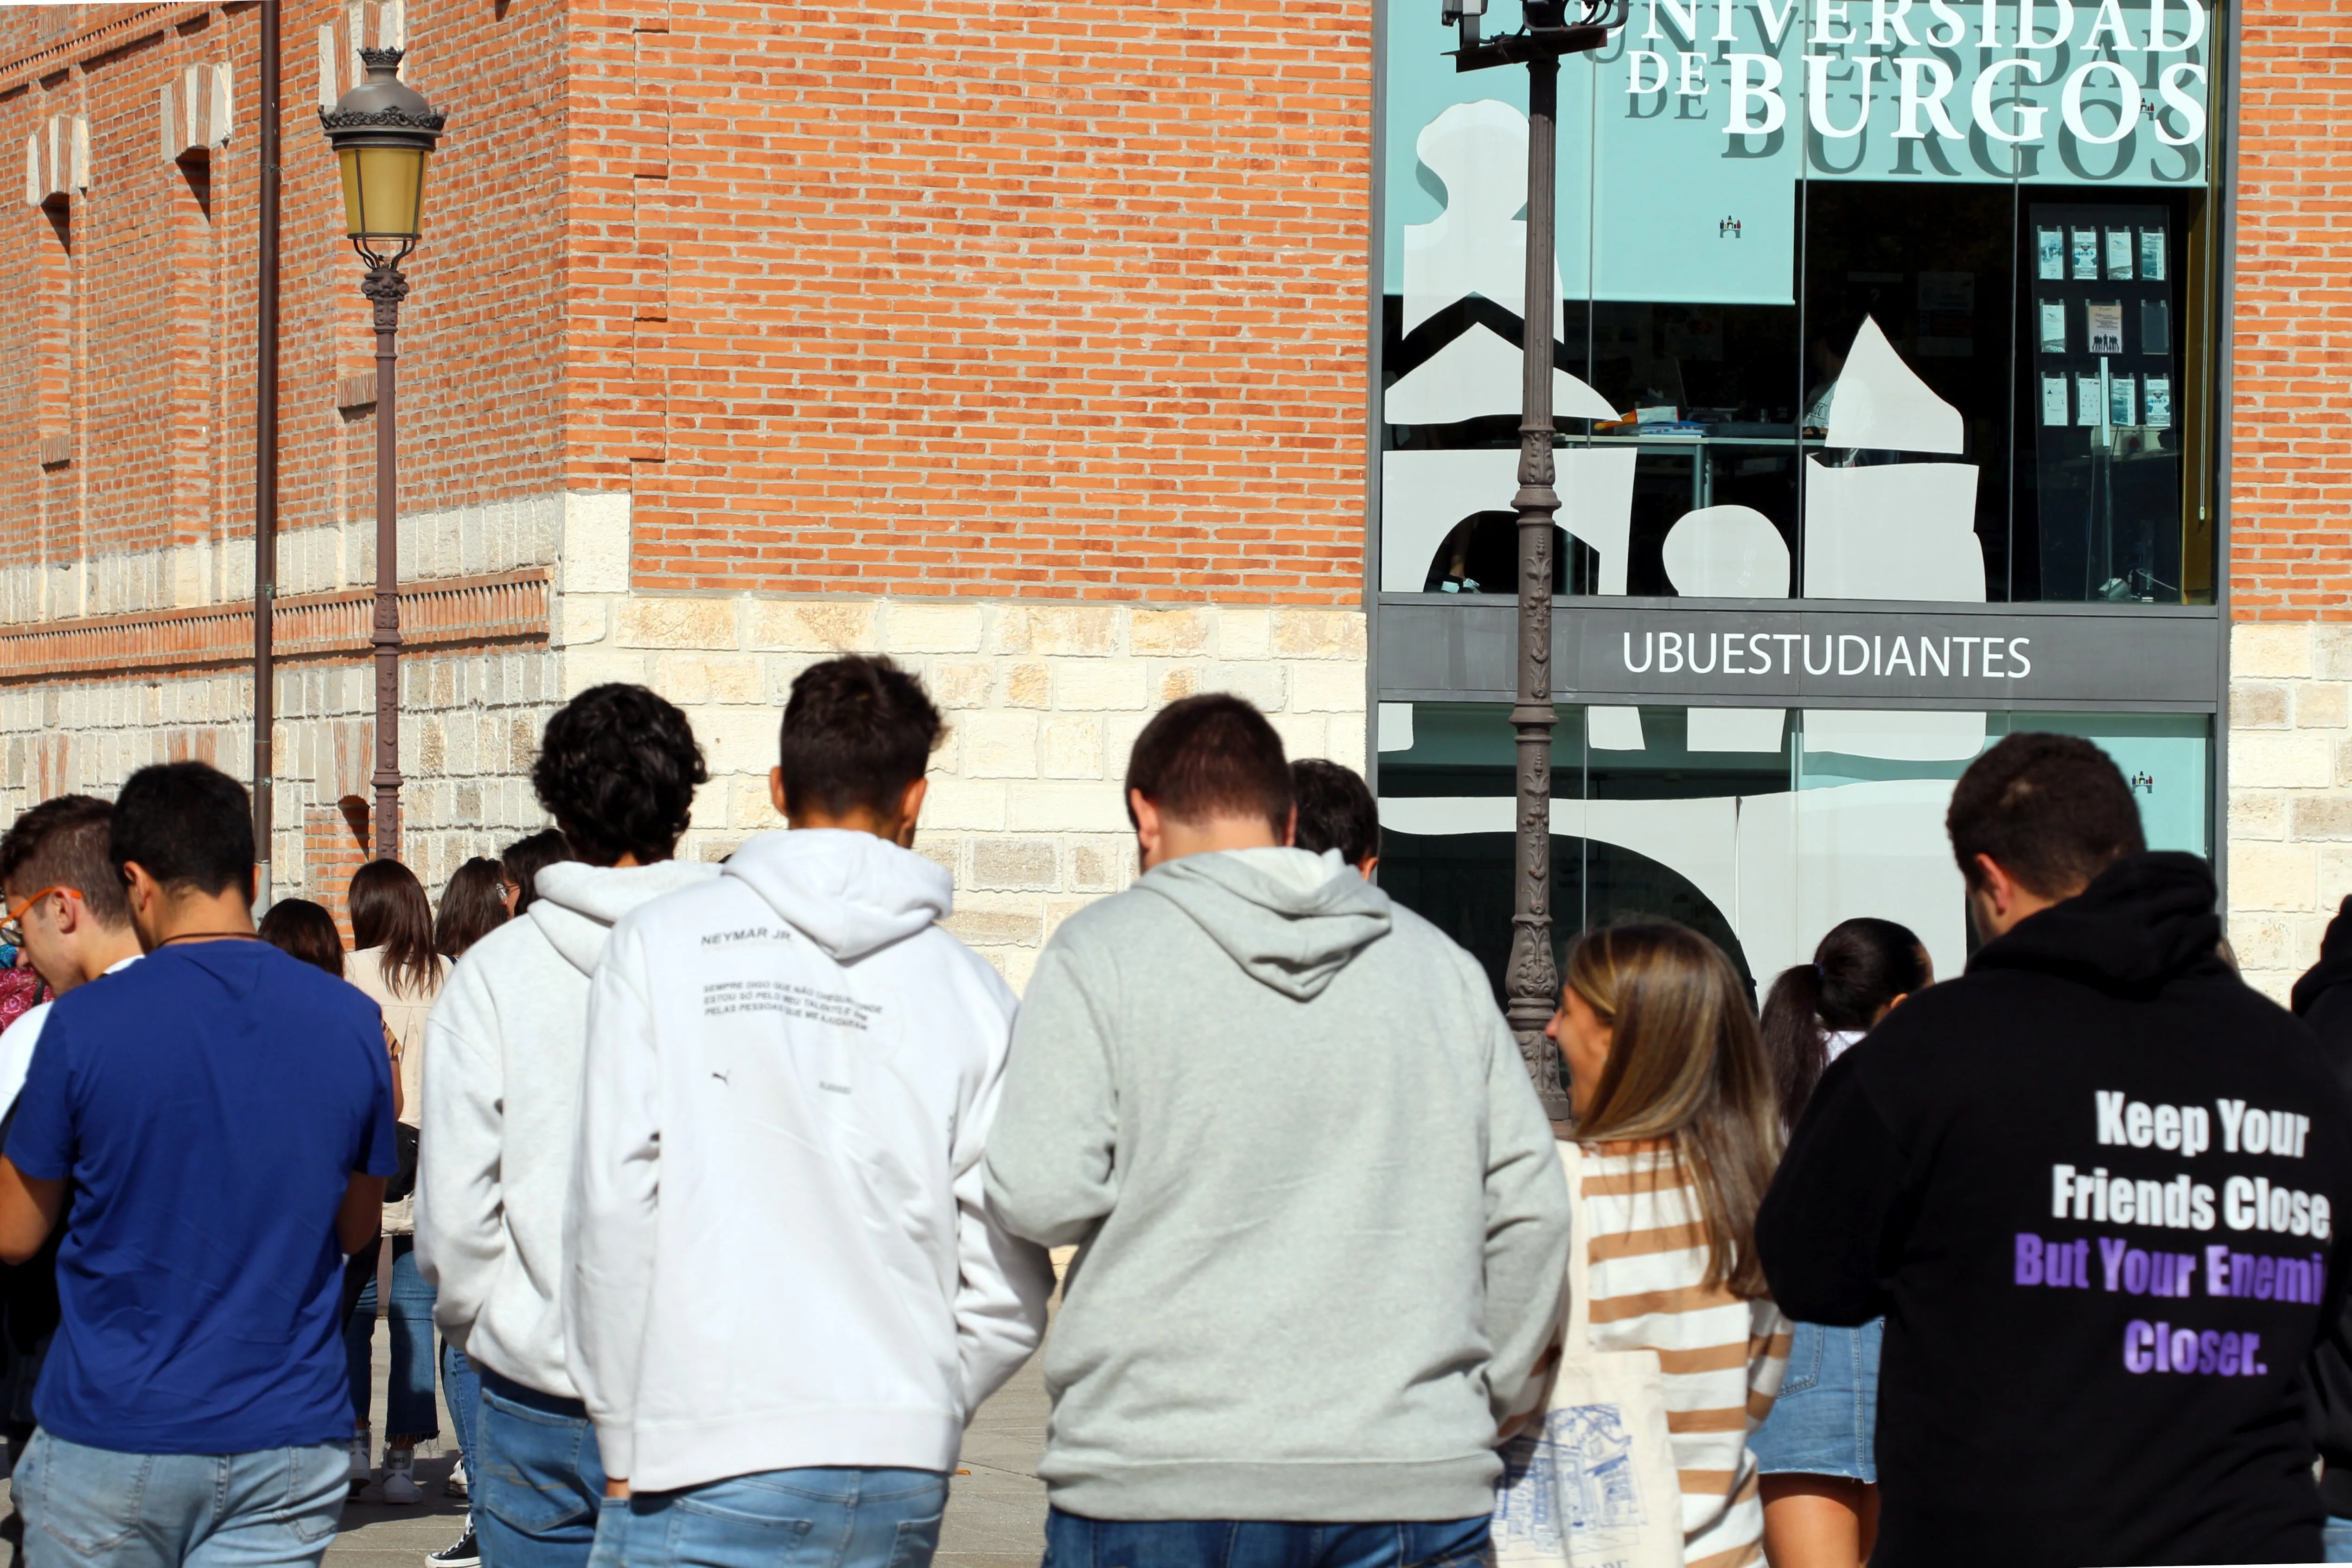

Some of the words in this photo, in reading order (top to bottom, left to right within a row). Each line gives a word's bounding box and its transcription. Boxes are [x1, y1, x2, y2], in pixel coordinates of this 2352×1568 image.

[1625, 50, 1709, 95] DE
[1722, 52, 2206, 146] BURGOS
[1624, 632, 2031, 678] UBUESTUDIANTES
[701, 927, 768, 945] NEYMAR
[2095, 1090, 2209, 1157] Keep
[2216, 1098, 2310, 1158] Your
[2052, 1164, 2216, 1231] Friends
[2014, 1232, 2090, 1289] But
[2098, 1237, 2196, 1298] Your
[2123, 1319, 2268, 1377] Closer.
